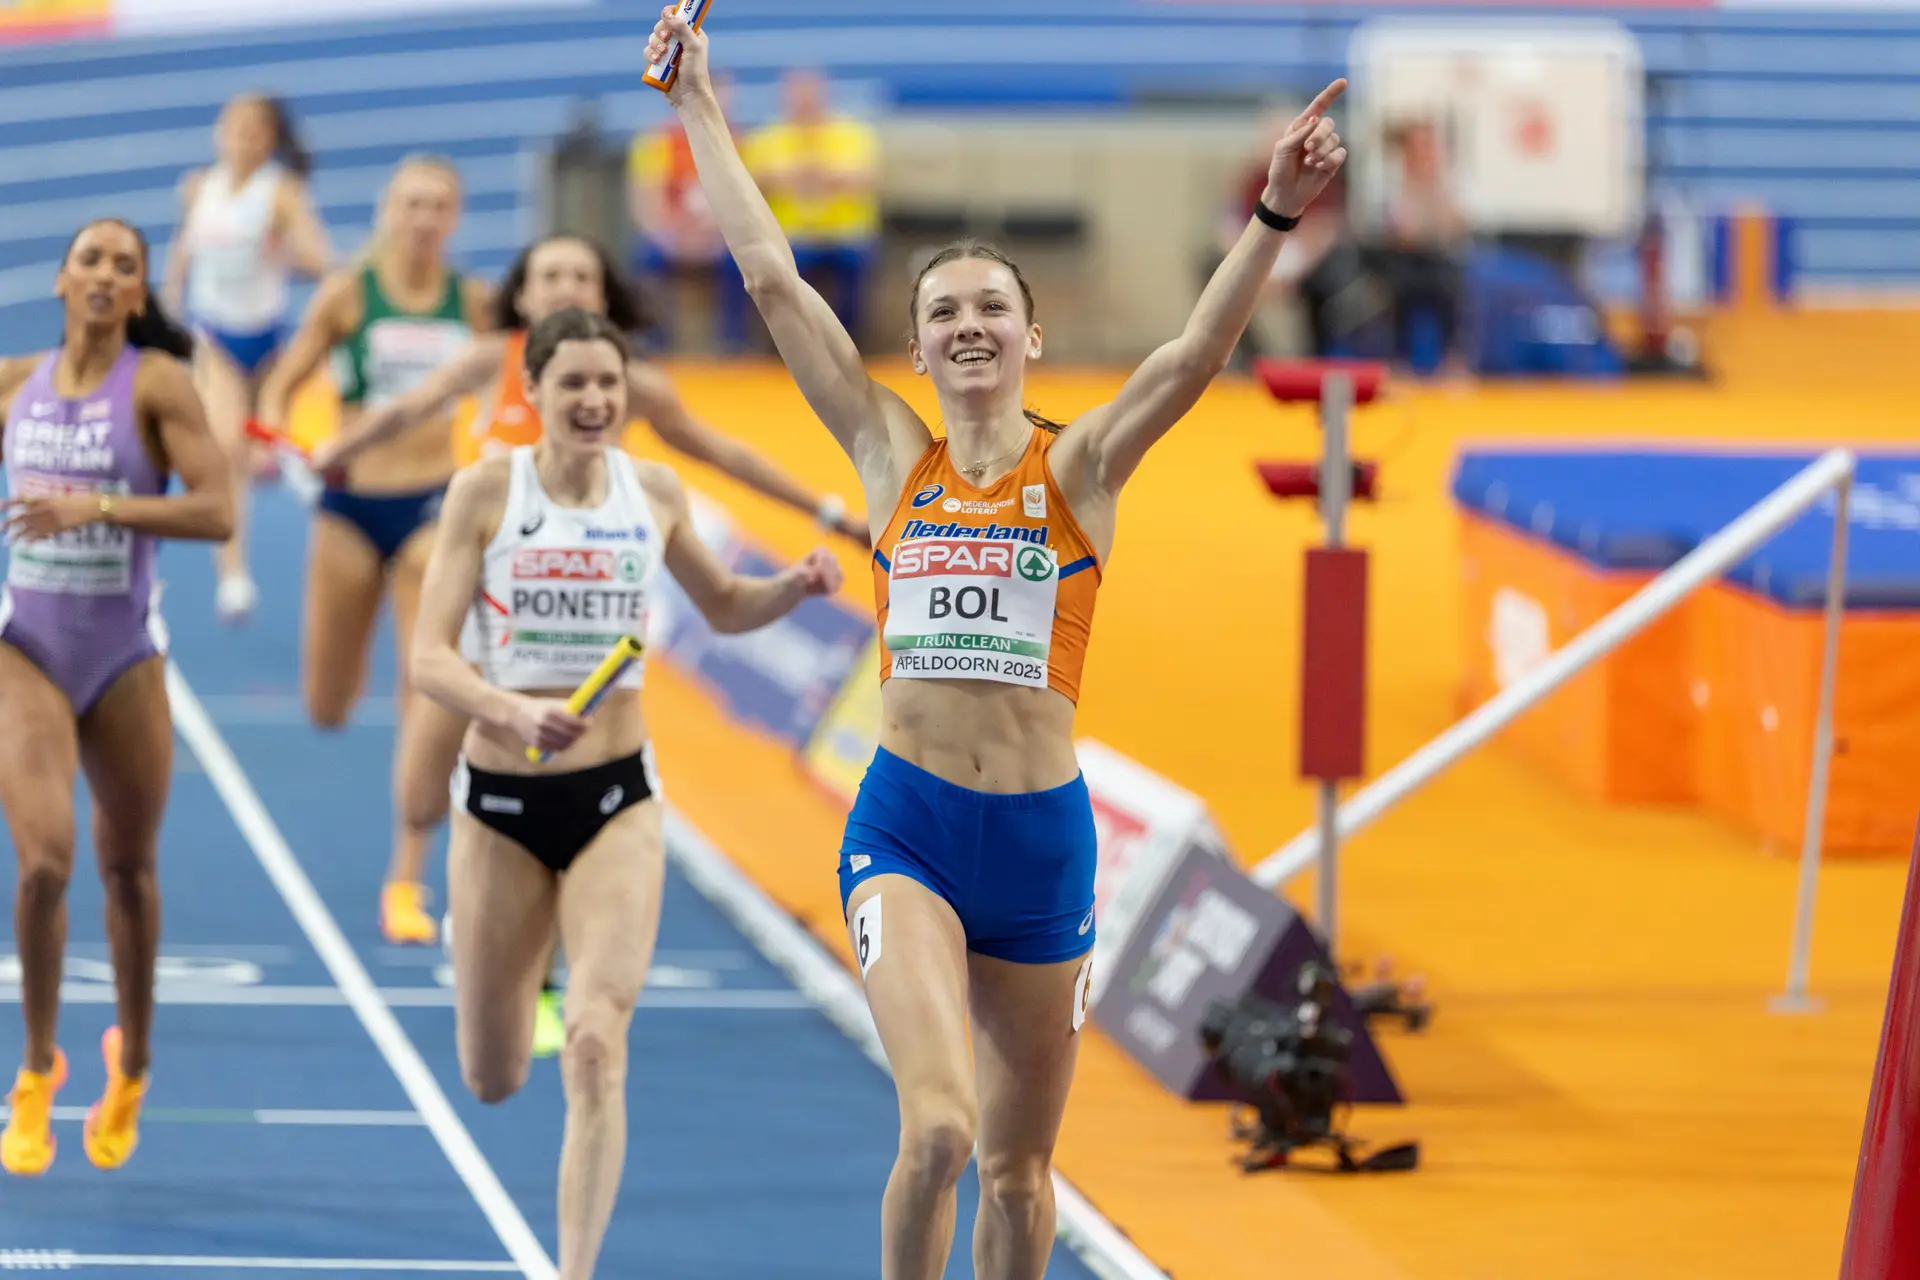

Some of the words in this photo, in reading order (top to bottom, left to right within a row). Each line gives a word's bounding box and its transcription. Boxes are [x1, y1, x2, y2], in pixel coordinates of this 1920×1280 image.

[961, 507, 998, 515] LOTERIJ
[962, 498, 1015, 509] NEDERLANDSE
[514, 550, 614, 578] SPAR
[896, 545, 1009, 574] SPAR
[513, 589, 645, 620] PONETTE
[929, 585, 1009, 623] BOL
[923, 635, 957, 648] RUN
[895, 655, 999, 673] APELDOORN
[1003, 660, 1042, 680] 2025
